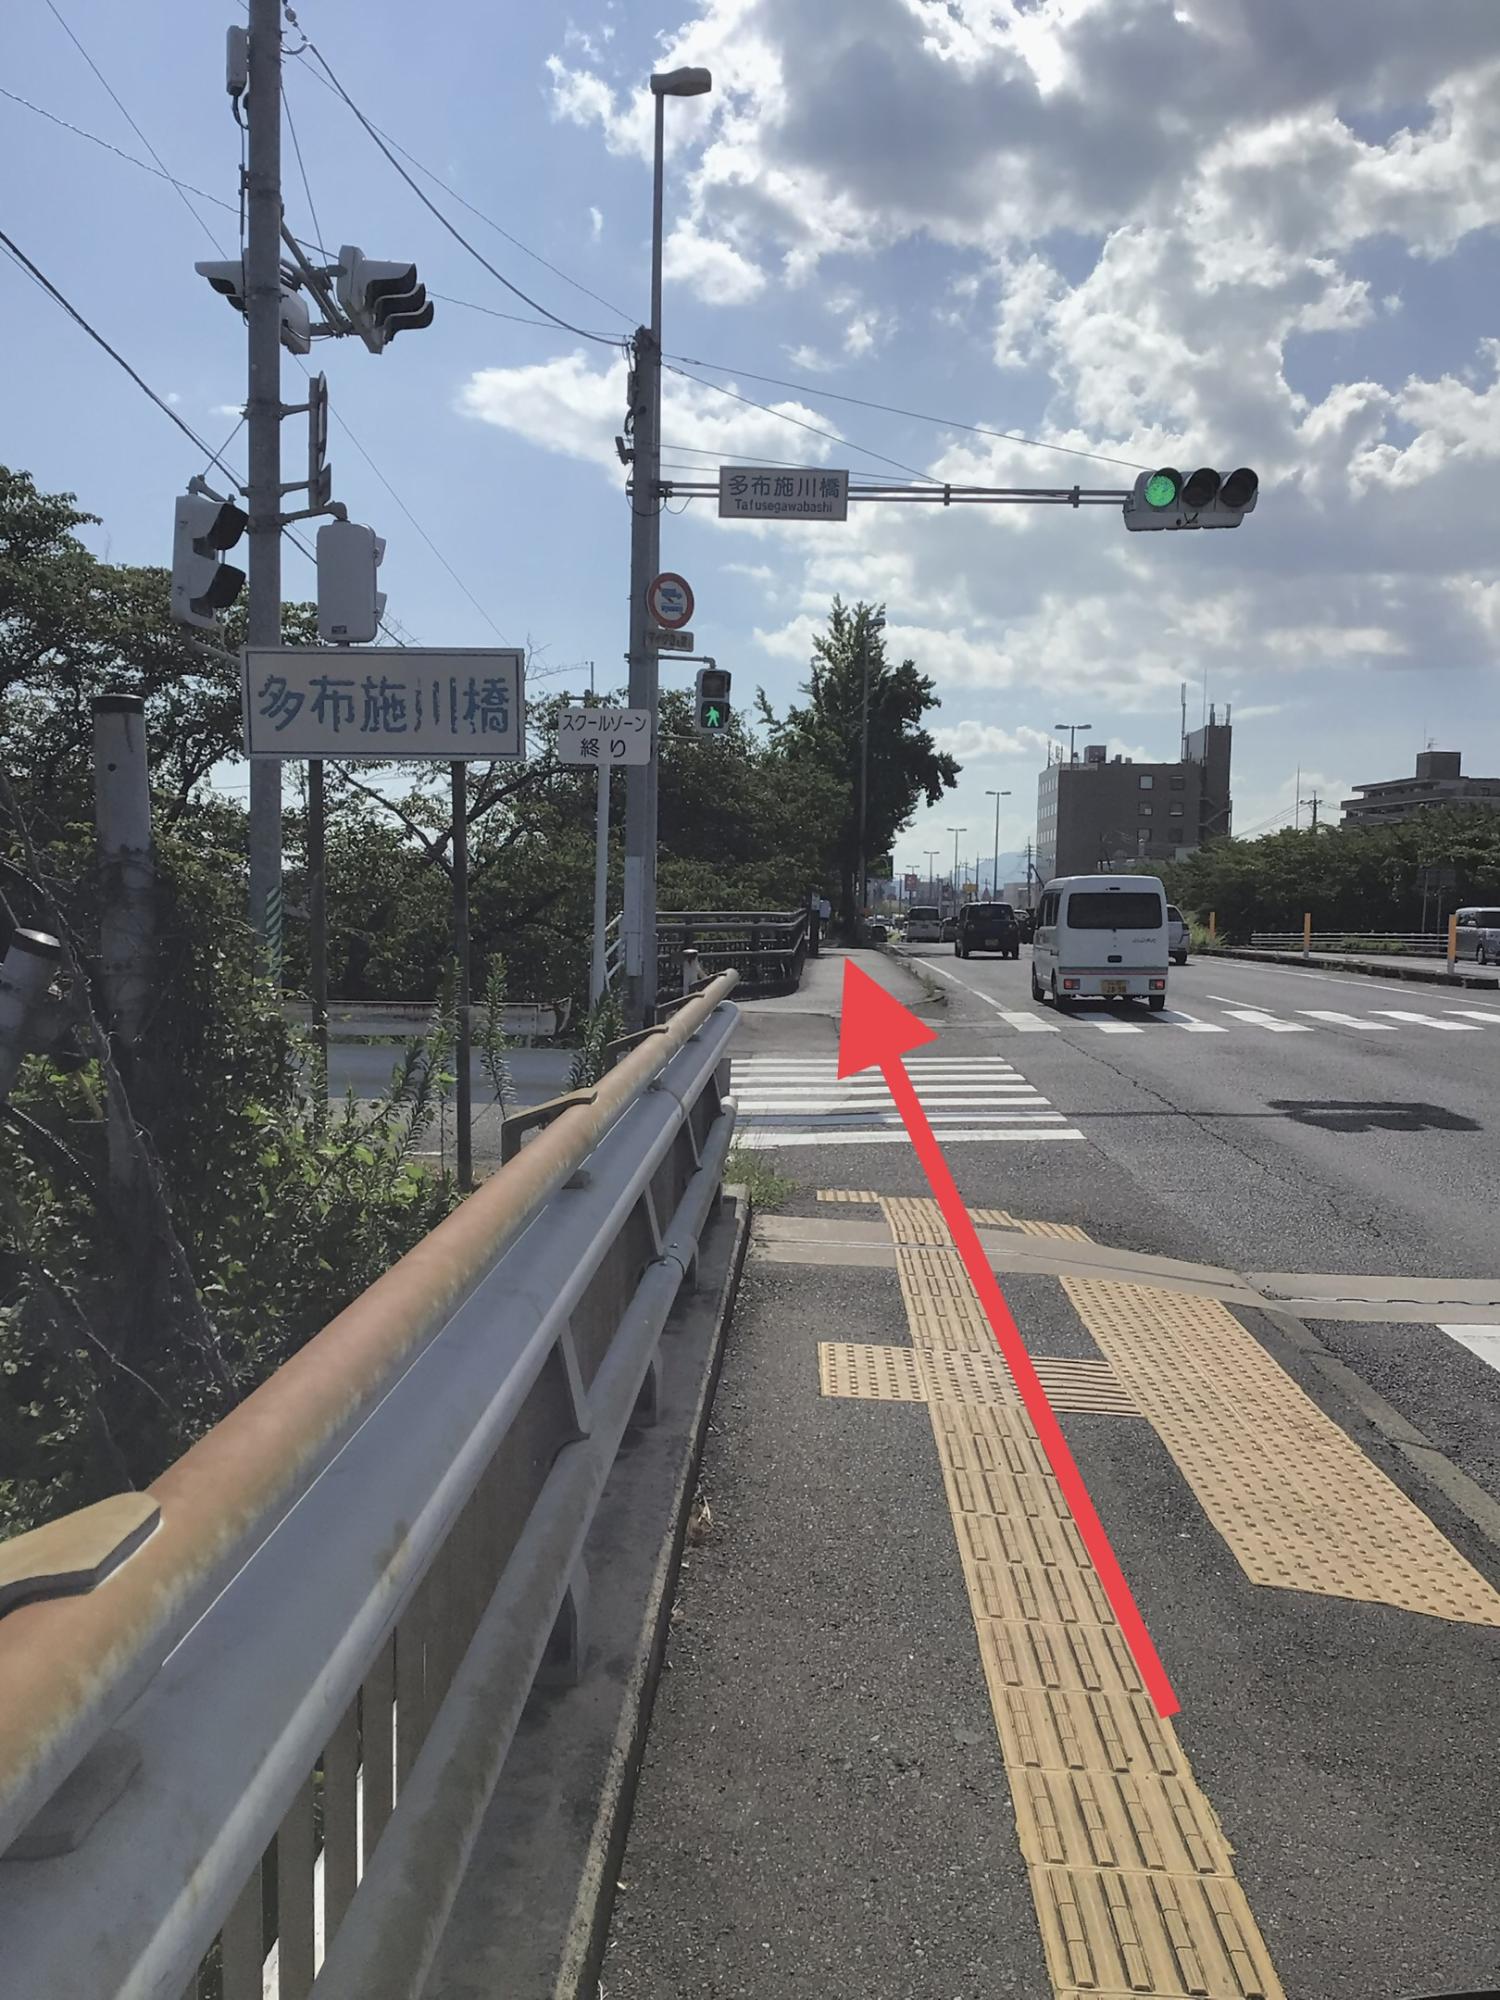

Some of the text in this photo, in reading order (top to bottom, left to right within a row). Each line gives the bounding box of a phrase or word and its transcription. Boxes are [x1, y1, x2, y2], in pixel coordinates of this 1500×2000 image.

[728, 475, 839, 498] 多布施川橋
[735, 499, 832, 513] Tafusegawabashi
[258, 674, 509, 734] 多布施川橋
